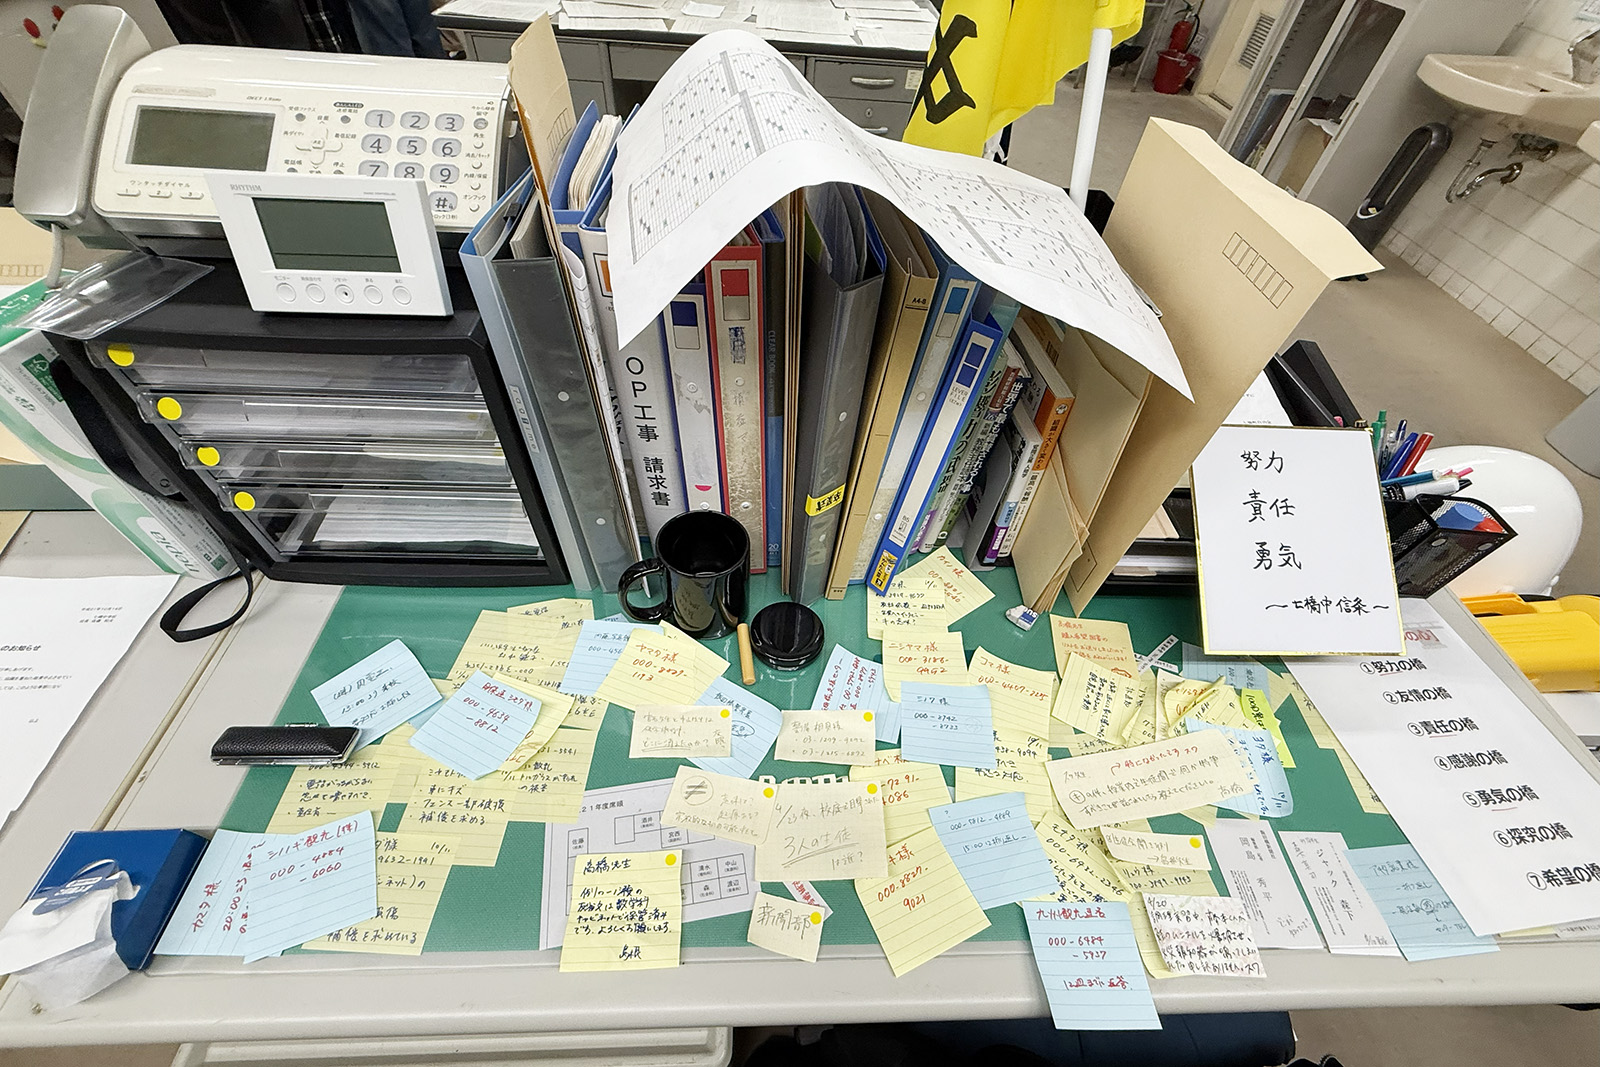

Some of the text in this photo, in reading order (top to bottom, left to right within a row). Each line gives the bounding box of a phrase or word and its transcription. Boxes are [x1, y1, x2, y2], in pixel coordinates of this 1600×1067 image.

[376, 113, 384, 125] 1
[409, 116, 421, 128] 2
[444, 117, 456, 130] 3
[370, 138, 382, 151] 4
[406, 140, 418, 153] 5
[441, 142, 453, 155] 6
[369, 165, 381, 178] 7
[440, 168, 452, 182] 9
[230, 183, 262, 192] RHYTHM
[949, 392, 966, 402] FILE
[951, 385, 969, 396] LEVER
[625, 356, 671, 507] OP工事 請求書
[1240, 449, 1285, 474] 努力
[1242, 488, 1296, 523] 責任
[150, 530, 200, 573] nepia
[1252, 541, 1302, 570] 勇気
[668, 830, 681, 838] 宮西
[583, 856, 632, 875] 高橋先生
[725, 859, 737, 867] 中山
[1316, 848, 1338, 888] ジャック
[757, 902, 812, 940] 新聞部
